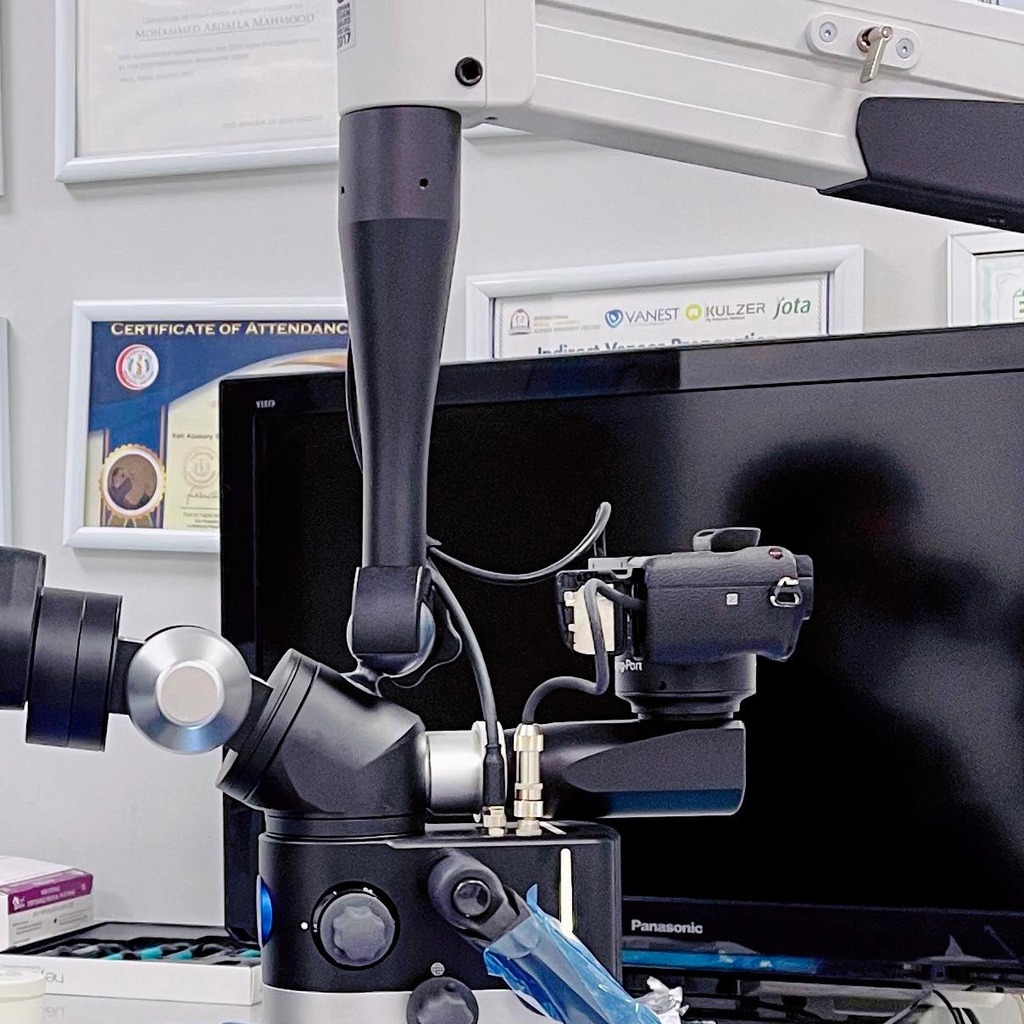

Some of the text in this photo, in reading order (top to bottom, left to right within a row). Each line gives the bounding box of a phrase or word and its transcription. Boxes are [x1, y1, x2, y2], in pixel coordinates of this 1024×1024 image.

[625, 307, 680, 324] VANEST
[705, 302, 766, 318] KULZER
[773, 297, 812, 320] jota
[110, 321, 348, 336] CERTIFICATE OF ATTENDANC
[630, 918, 704, 935] Panasonic
